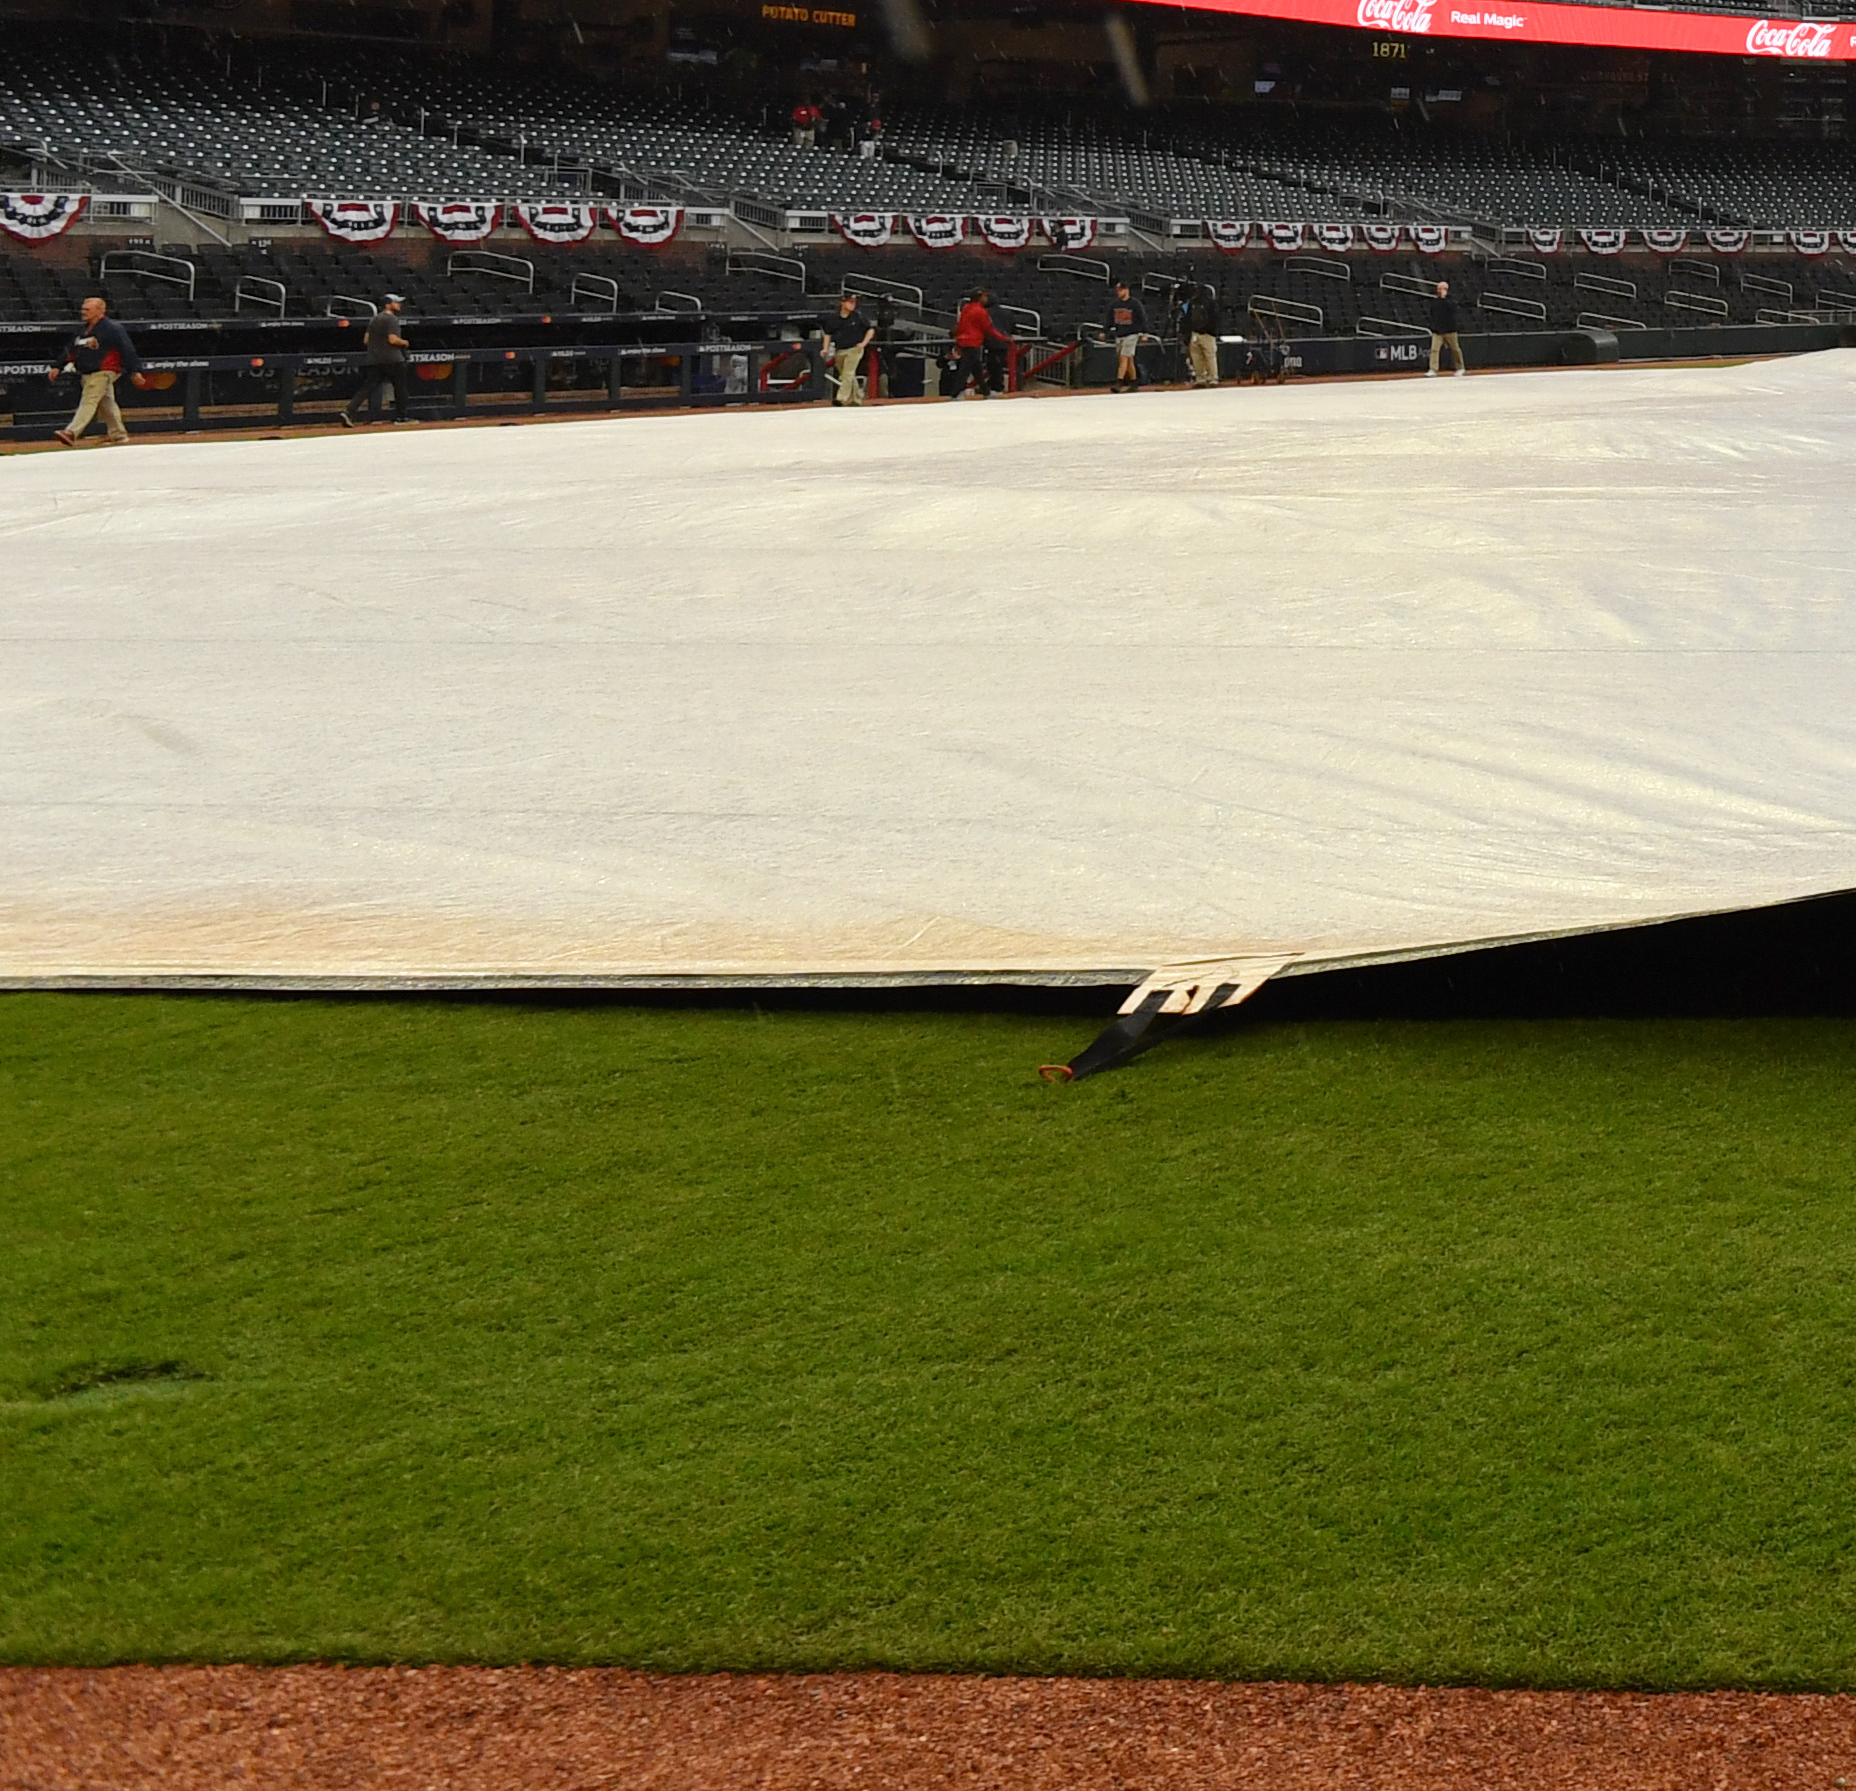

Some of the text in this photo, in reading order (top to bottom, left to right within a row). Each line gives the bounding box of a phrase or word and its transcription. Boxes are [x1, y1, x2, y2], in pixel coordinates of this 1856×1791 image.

[762, 4, 856, 27] POTATO CUTTER
[1450, 9, 1482, 24] Real
[1484, 12, 1525, 29] Magic
[1745, 19, 1837, 58] Coca-Cola
[1372, 42, 1407, 58] 1871
[1390, 344, 1418, 361] MLB
